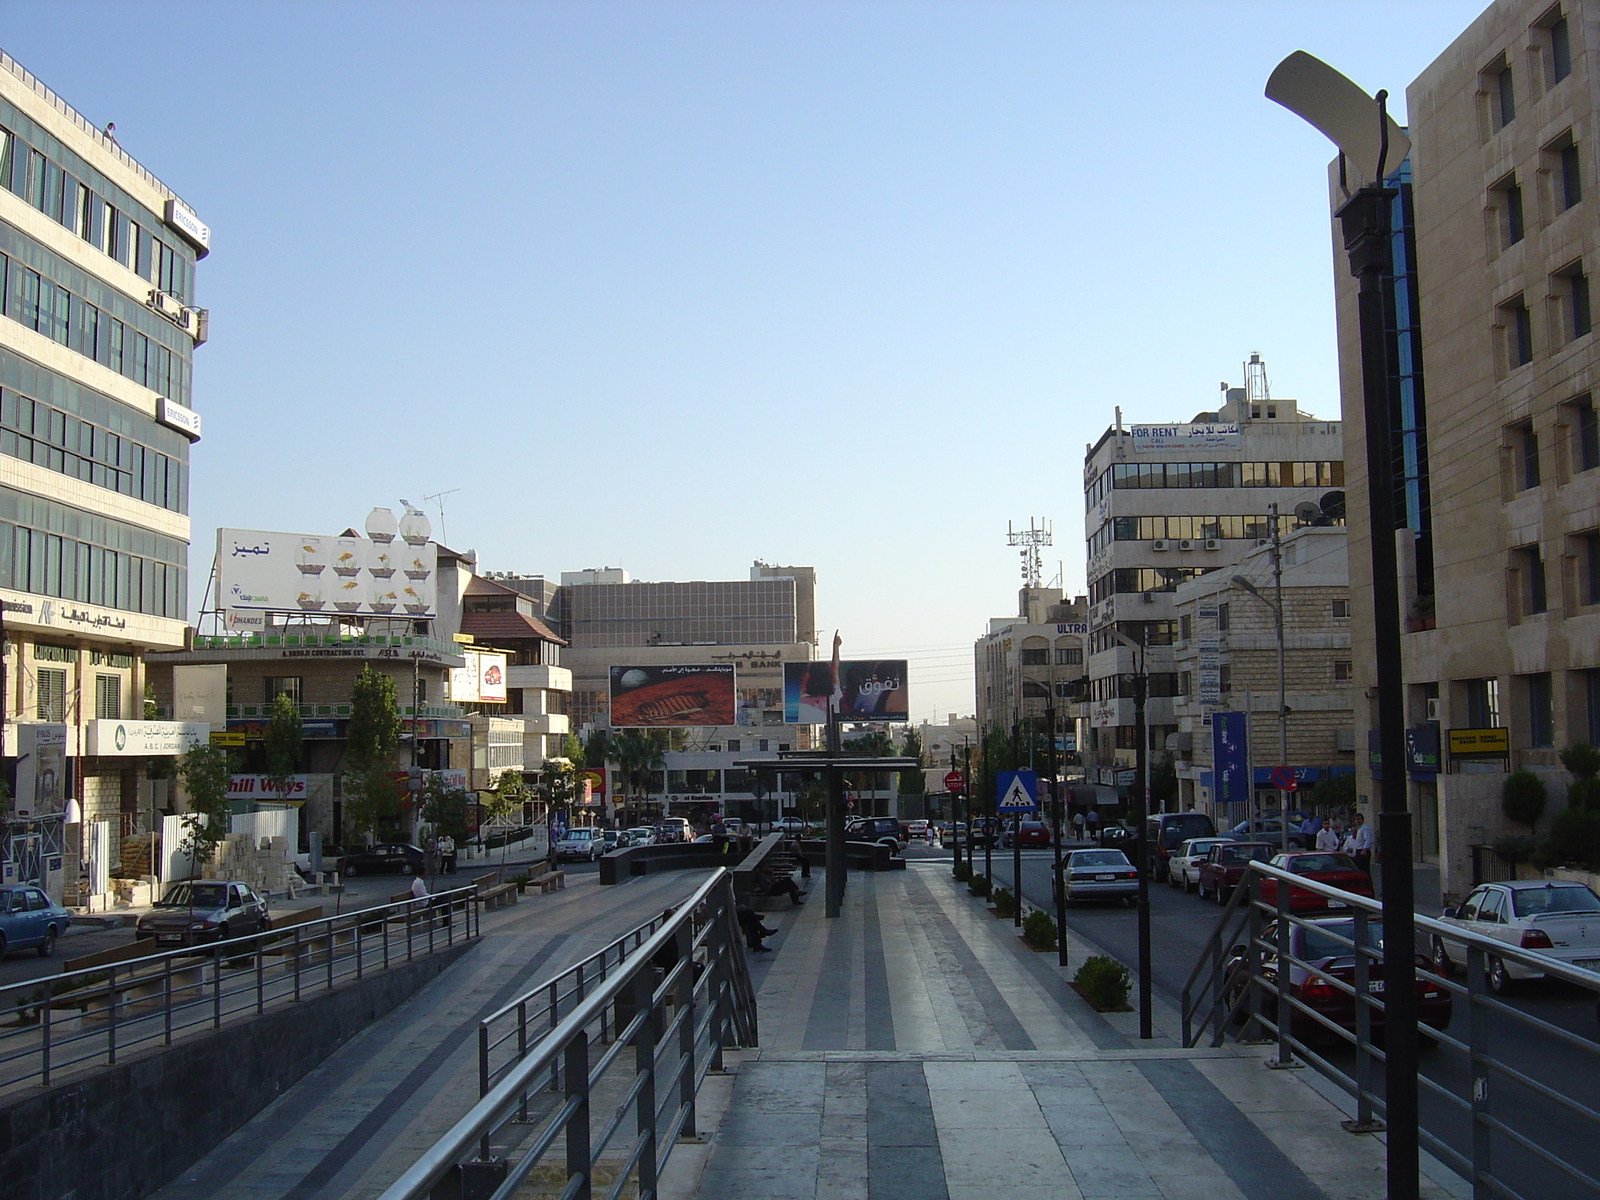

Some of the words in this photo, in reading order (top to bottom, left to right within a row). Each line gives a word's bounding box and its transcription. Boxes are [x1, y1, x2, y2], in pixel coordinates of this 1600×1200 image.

[176, 210, 198, 235] ERICSSON
[167, 407, 190, 426] ERICSSON
[1131, 428, 1149, 438] FOR
[1152, 427, 1178, 437] RENT
[1057, 623, 1087, 634] ULTRA
[750, 661, 781, 669] BANK
[227, 778, 256, 793] hili
